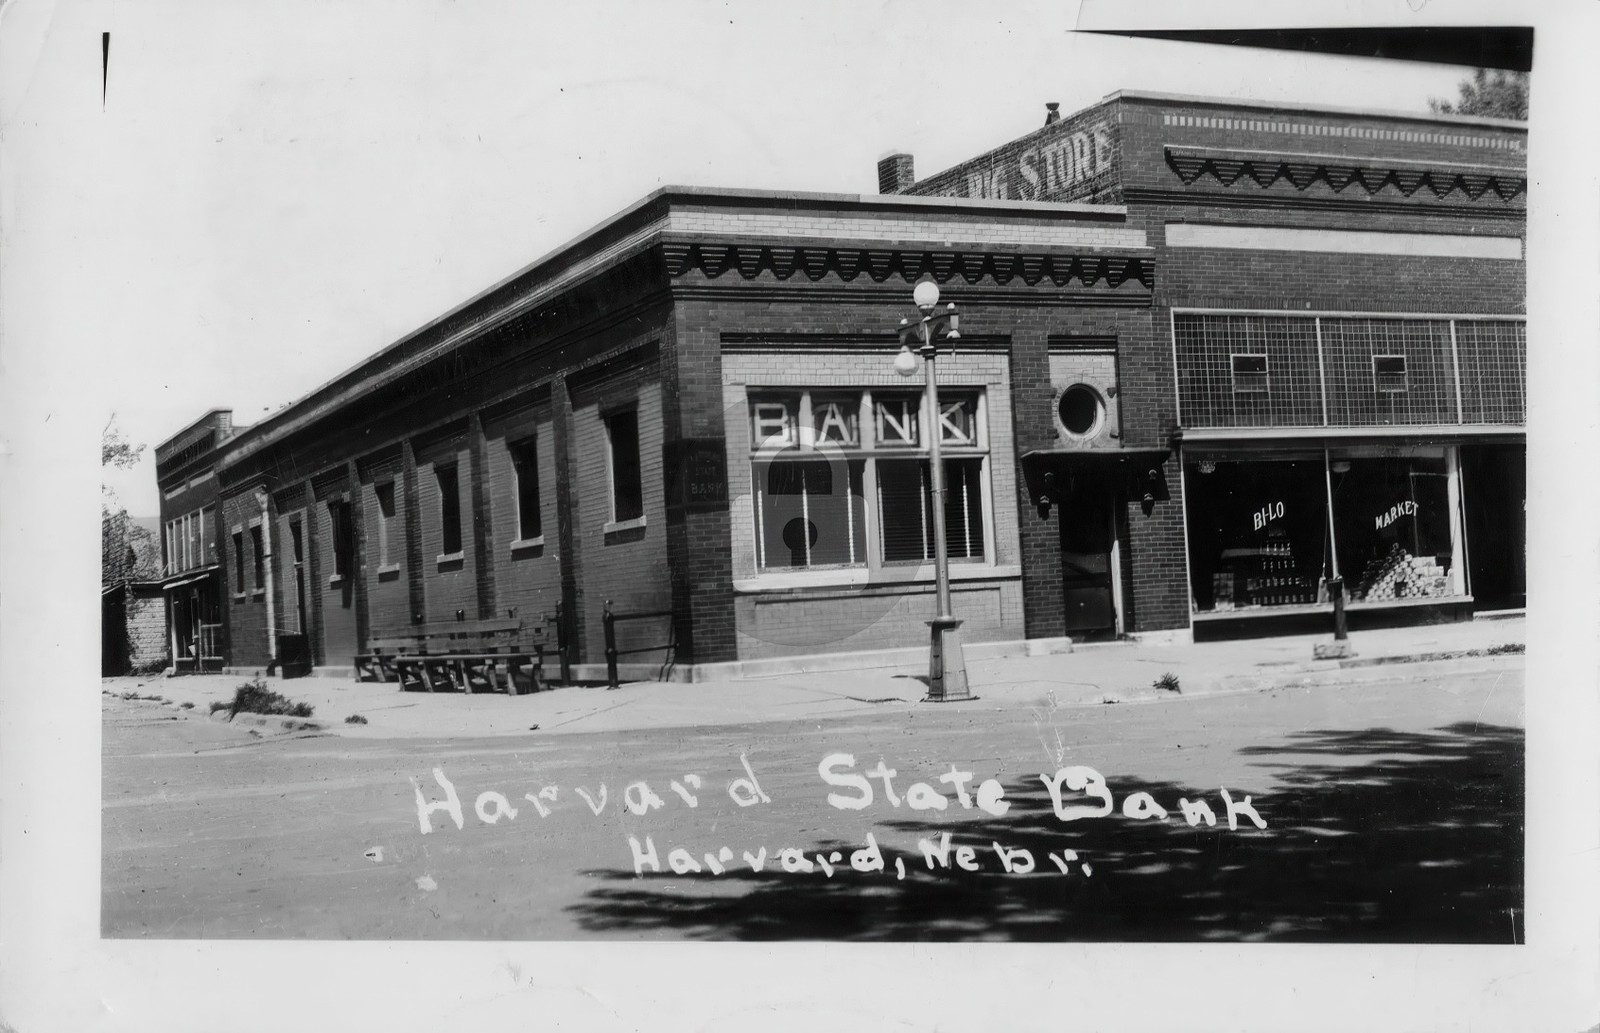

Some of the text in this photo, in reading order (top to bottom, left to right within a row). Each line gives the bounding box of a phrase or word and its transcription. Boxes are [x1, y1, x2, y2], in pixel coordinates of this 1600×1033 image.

[1018, 122, 1113, 200] STORE
[754, 401, 972, 446] BANK
[1253, 501, 1285, 531] BI-LO
[1375, 500, 1419, 531] MARKET
